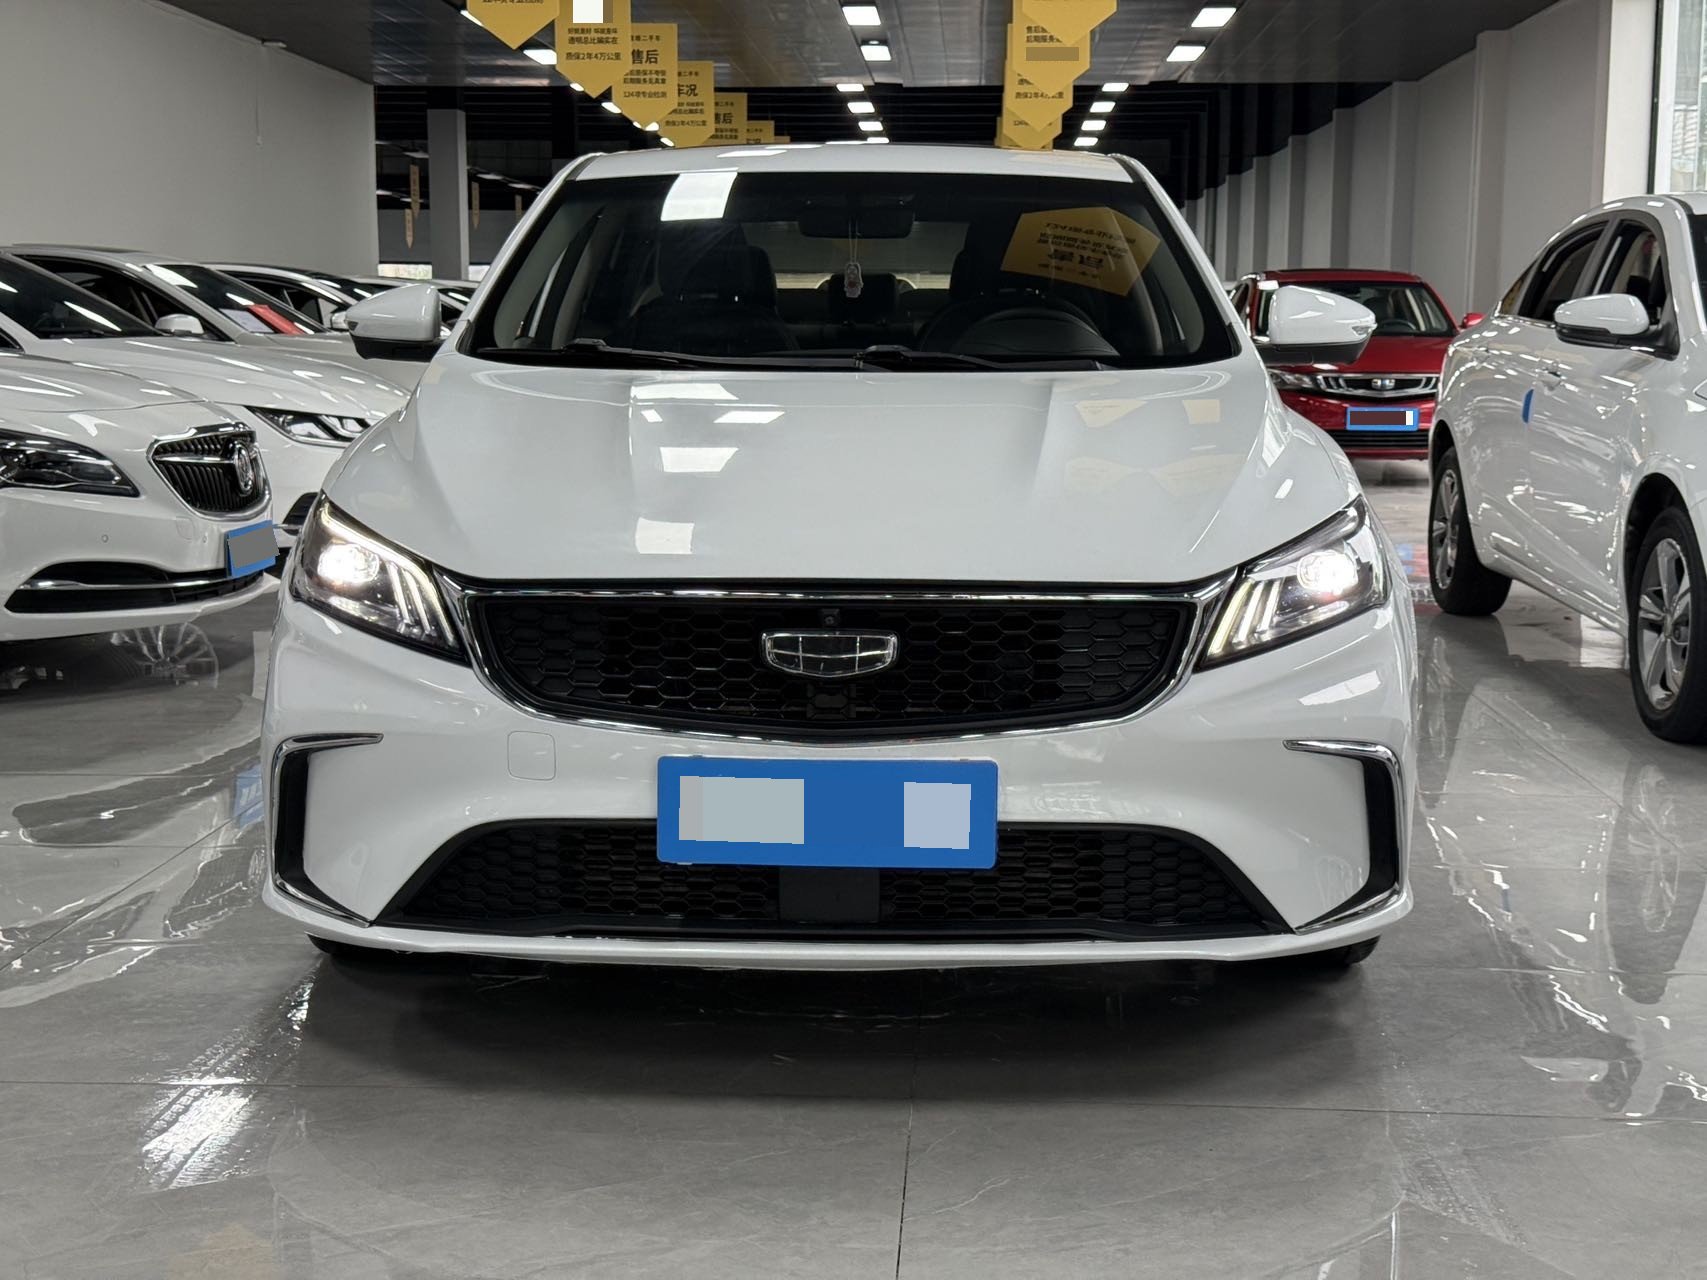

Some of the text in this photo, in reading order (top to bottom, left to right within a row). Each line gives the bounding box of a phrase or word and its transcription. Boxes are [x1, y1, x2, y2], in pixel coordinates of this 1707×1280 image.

[566, 52, 621, 61] 质保2年4万公里
[631, 49, 660, 65] 售后
[624, 91, 667, 99] 124项专业检测
[678, 84, 699, 98] 车况
